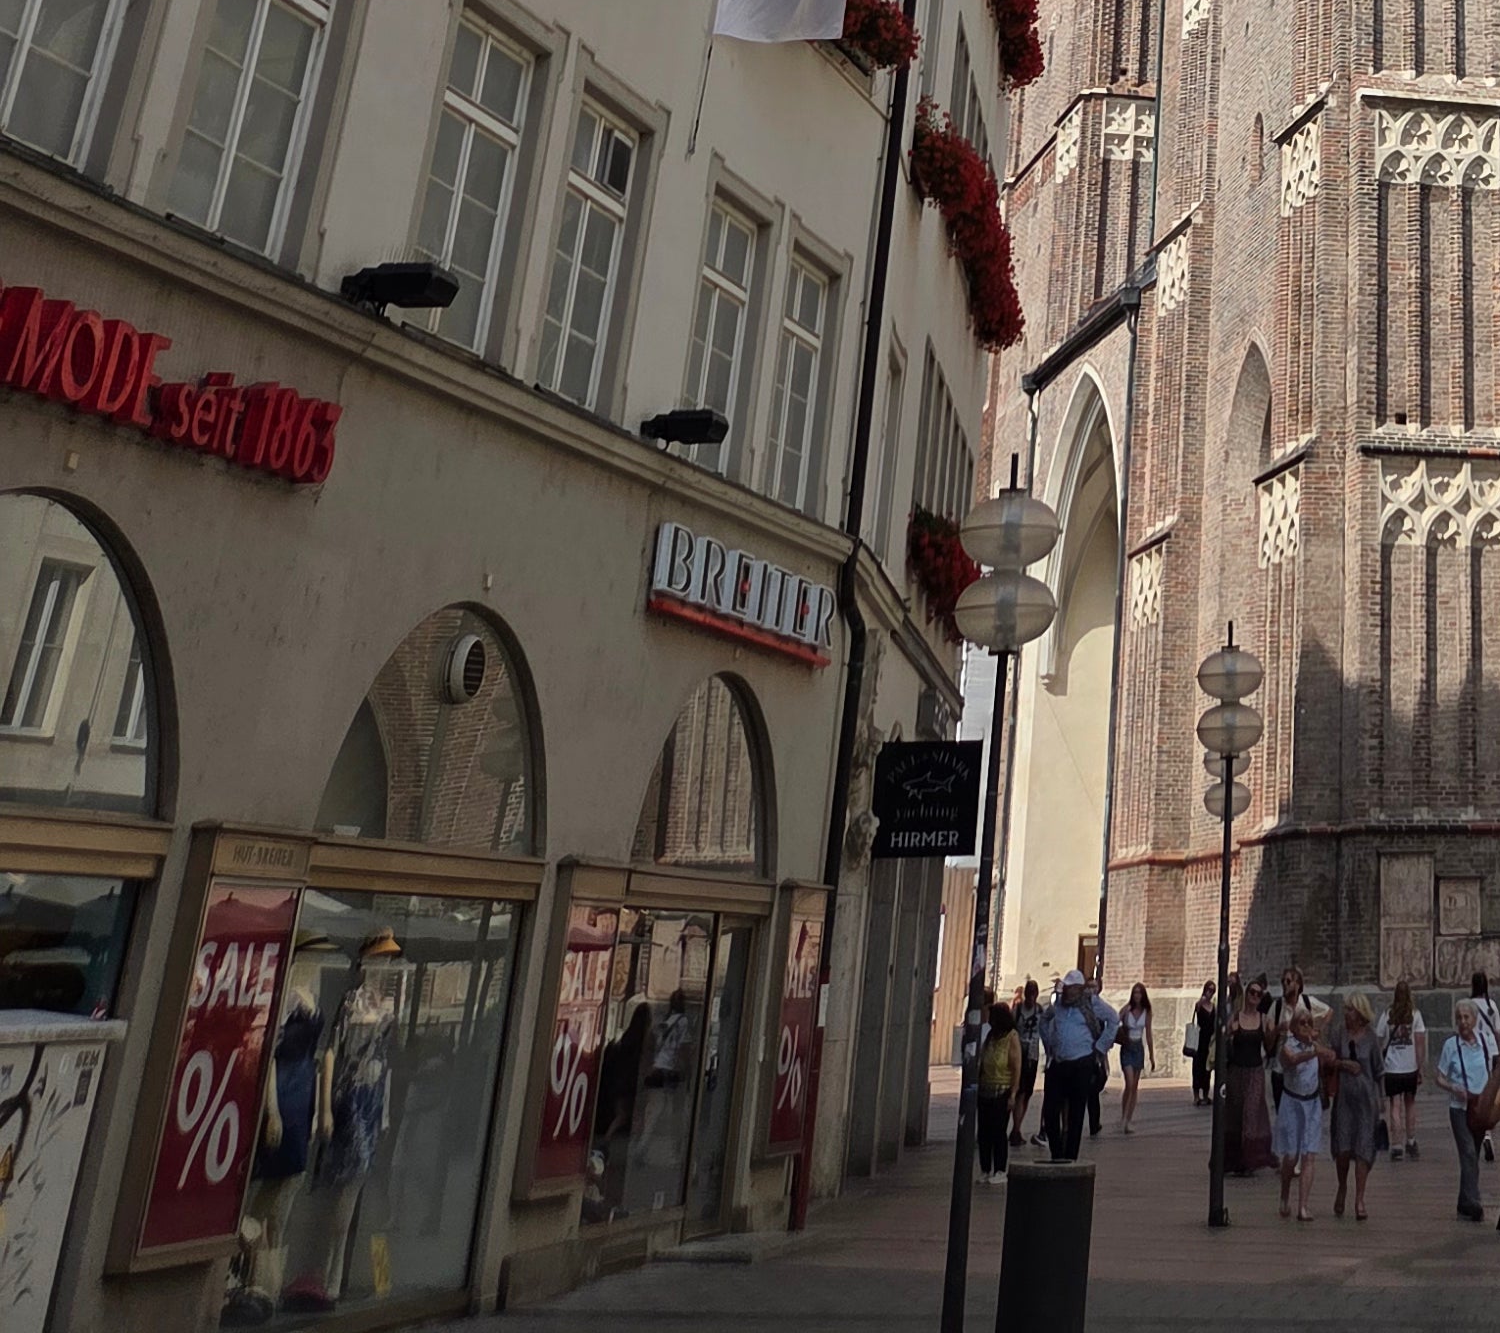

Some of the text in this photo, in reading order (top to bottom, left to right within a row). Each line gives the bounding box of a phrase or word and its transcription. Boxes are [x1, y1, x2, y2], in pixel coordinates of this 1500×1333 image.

[4, 287, 173, 426] MODE
[171, 372, 245, 458] seit
[658, 523, 837, 649] BREITER
[890, 830, 960, 848] HIRMER
[189, 941, 280, 1008] SALE
